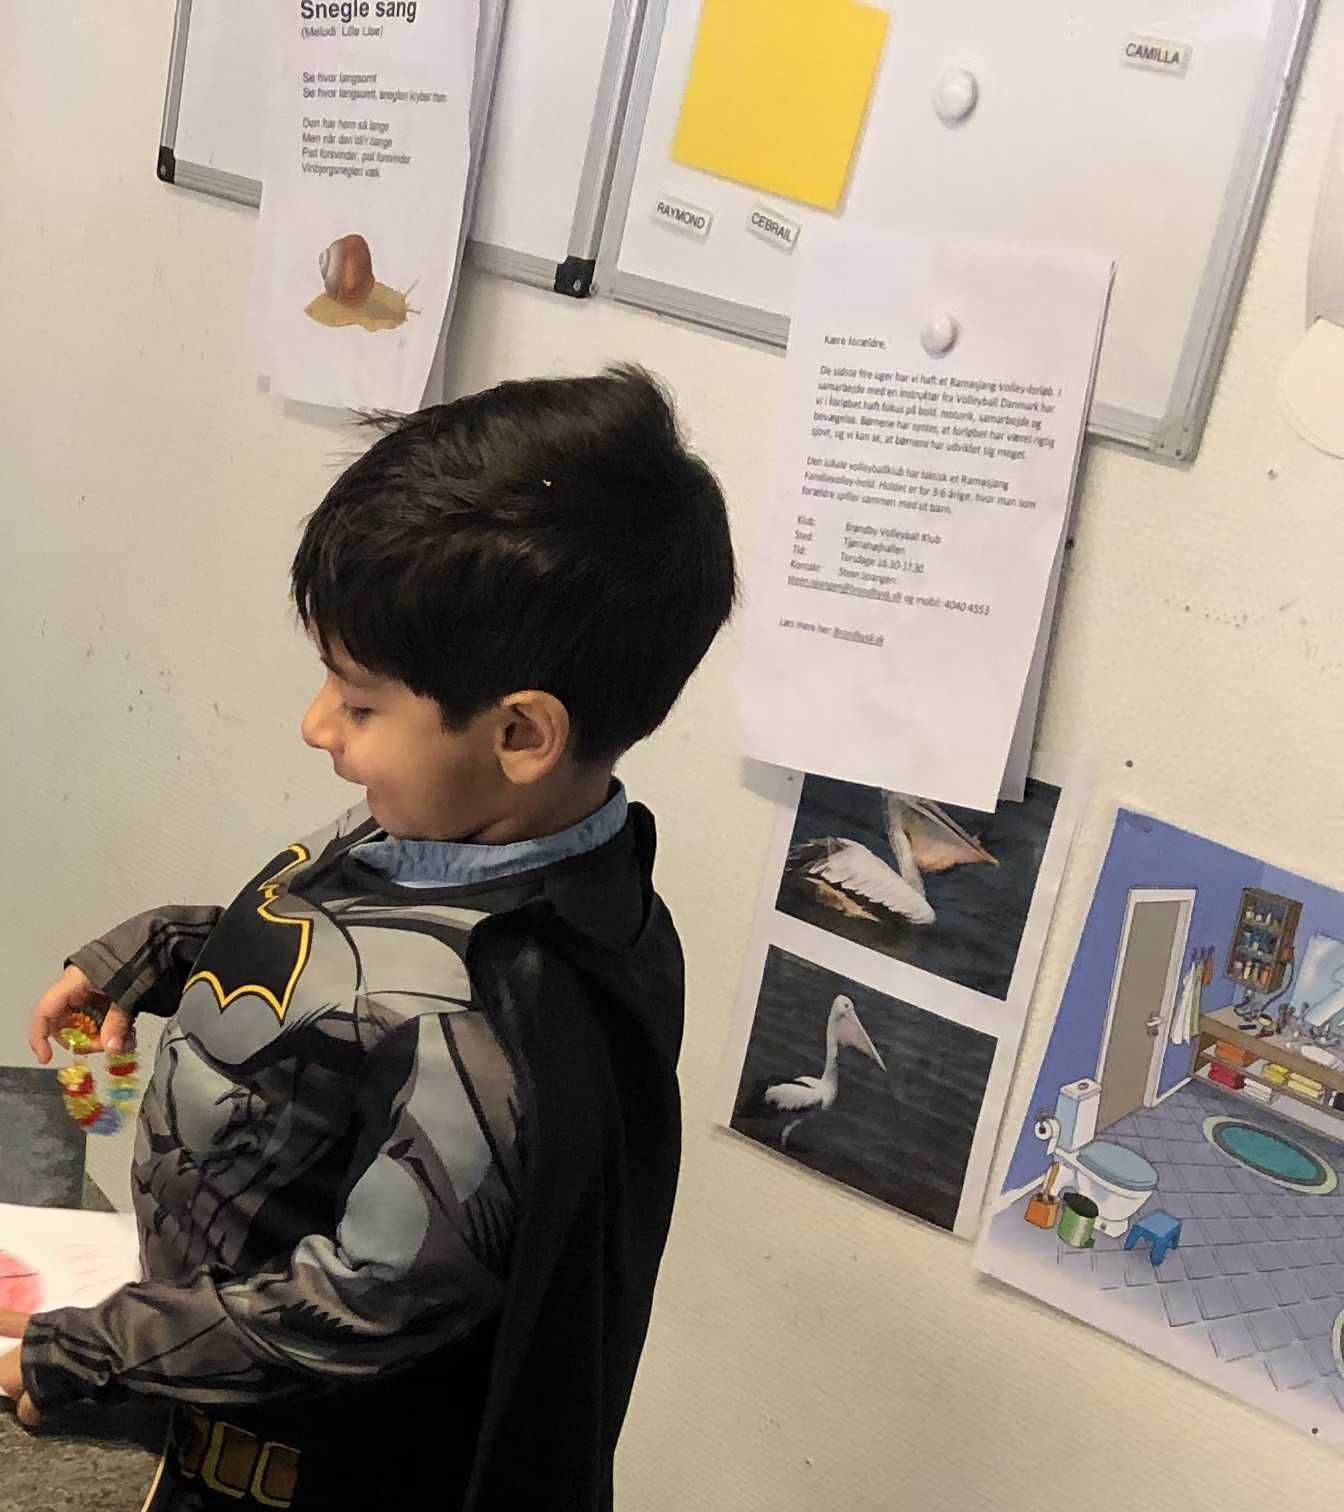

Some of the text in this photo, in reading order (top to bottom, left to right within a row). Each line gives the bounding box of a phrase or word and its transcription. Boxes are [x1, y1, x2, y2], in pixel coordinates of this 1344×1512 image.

[301, 0, 417, 23] Snegle sang
[1126, 42, 1179, 65] CAMILLA
[657, 201, 705, 230] RAYMOND
[751, 212, 792, 242] CEBRAIL
[824, 335, 845, 346] Kære
[943, 599, 966, 613] 4040
